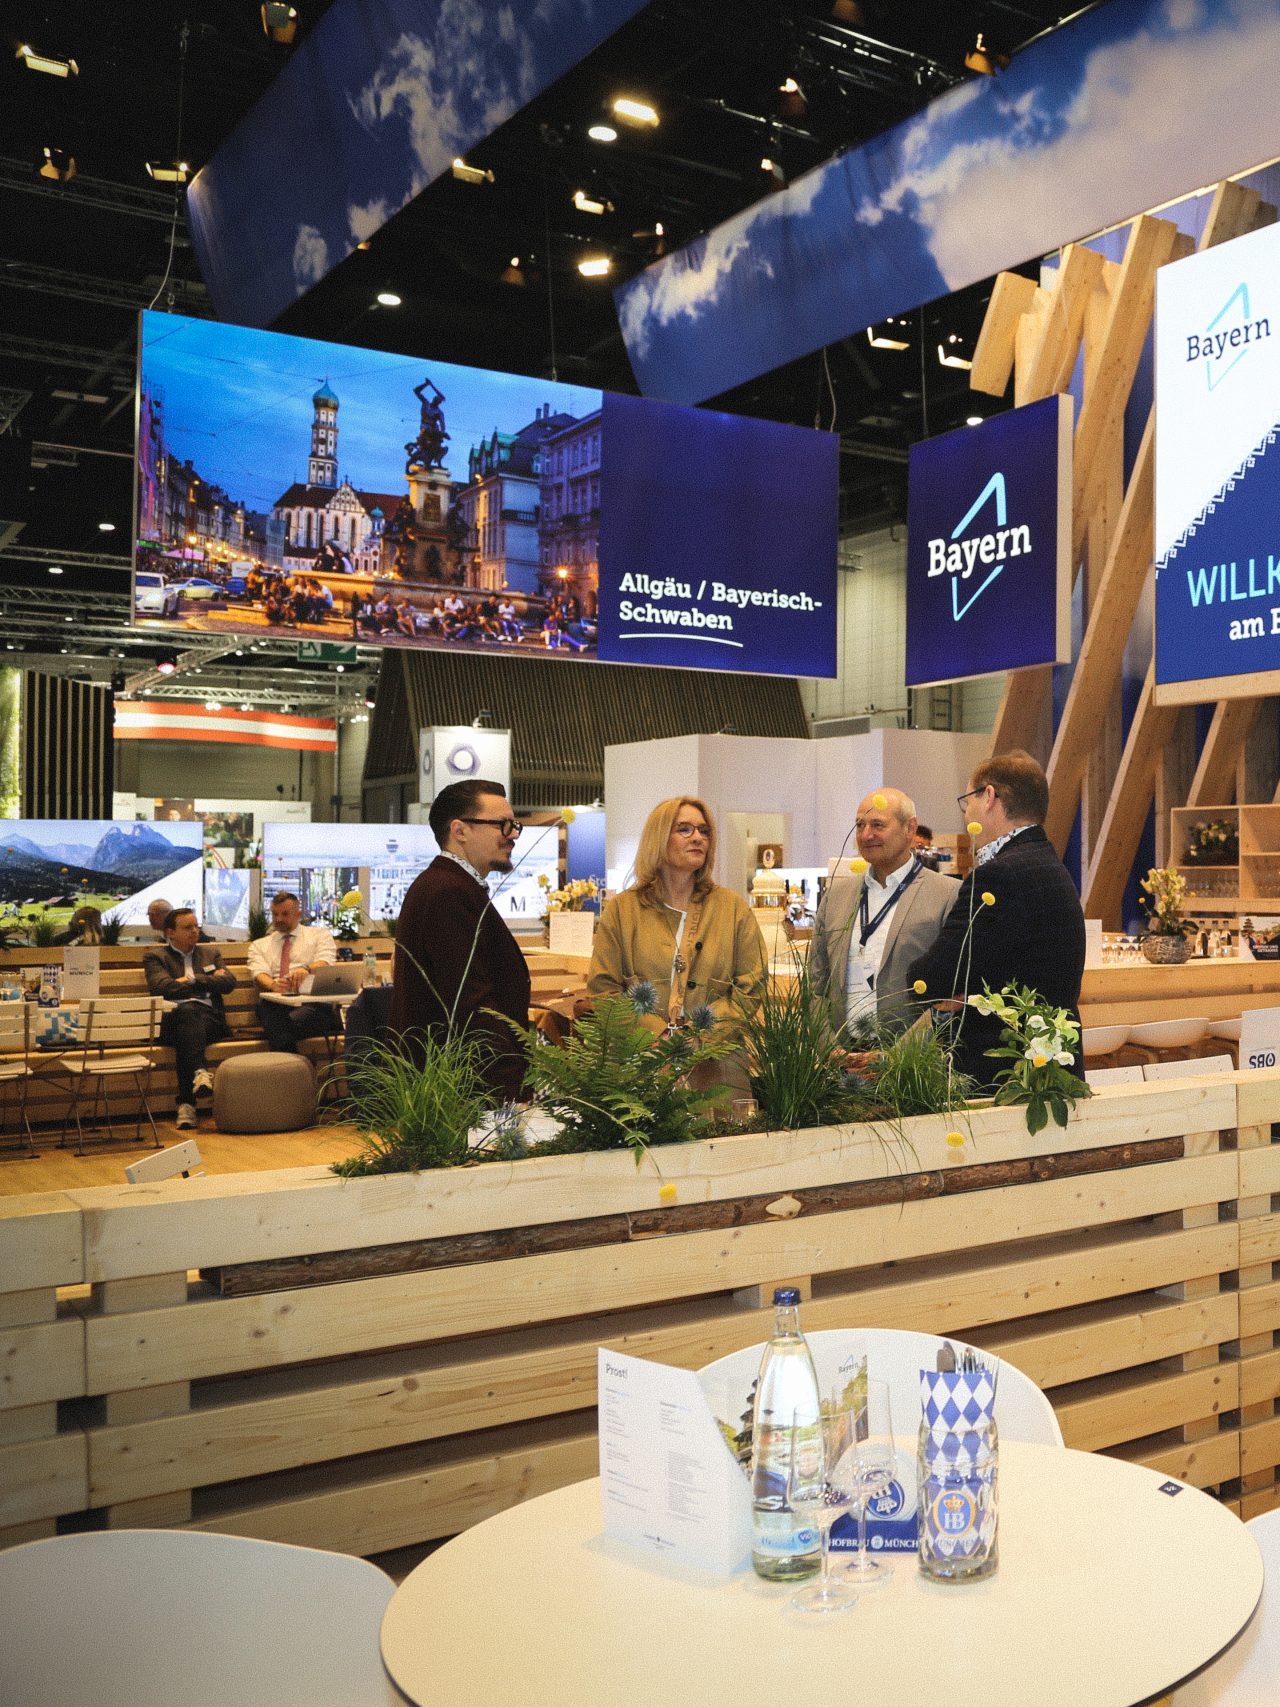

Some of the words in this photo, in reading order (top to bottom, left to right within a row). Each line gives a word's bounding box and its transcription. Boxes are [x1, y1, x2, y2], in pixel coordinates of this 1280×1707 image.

[1186, 317, 1272, 362] Bayern
[927, 524, 1032, 579] Bayern
[619, 572, 691, 600] Allgäu
[711, 582, 823, 611] Bayerisch-
[619, 601, 733, 630] Schwaben
[1229, 616, 1265, 640] am
